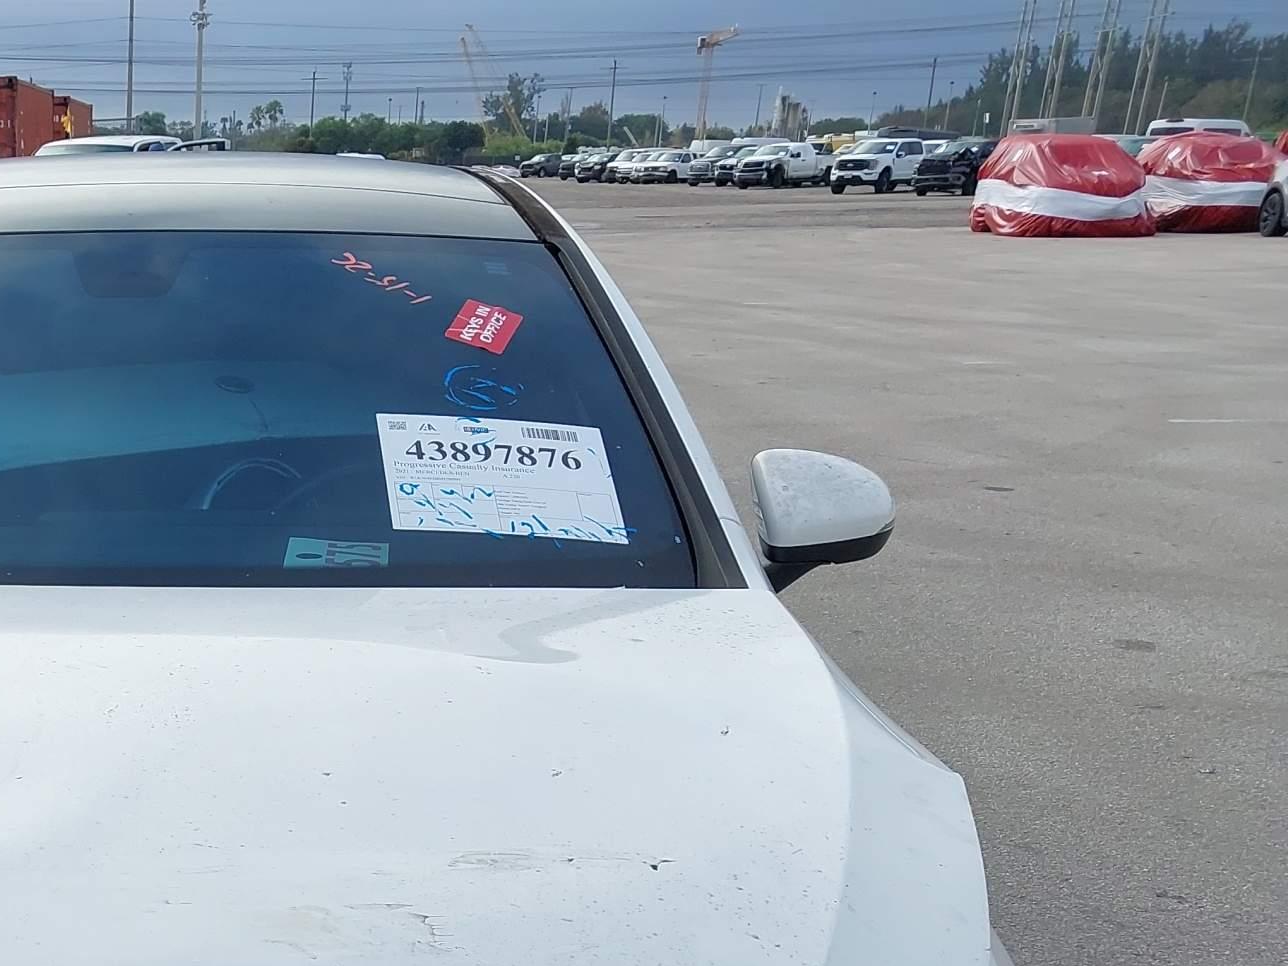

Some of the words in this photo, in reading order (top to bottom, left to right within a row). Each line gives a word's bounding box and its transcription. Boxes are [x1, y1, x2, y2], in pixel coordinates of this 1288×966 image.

[460, 316, 484, 341] KEYS
[475, 304, 491, 317] IN
[479, 311, 507, 343] OFFICE
[393, 460, 447, 469] Progressive
[449, 462, 489, 472] Casualty
[491, 465, 536, 474] Insurance
[405, 439, 582, 471] 43897876
